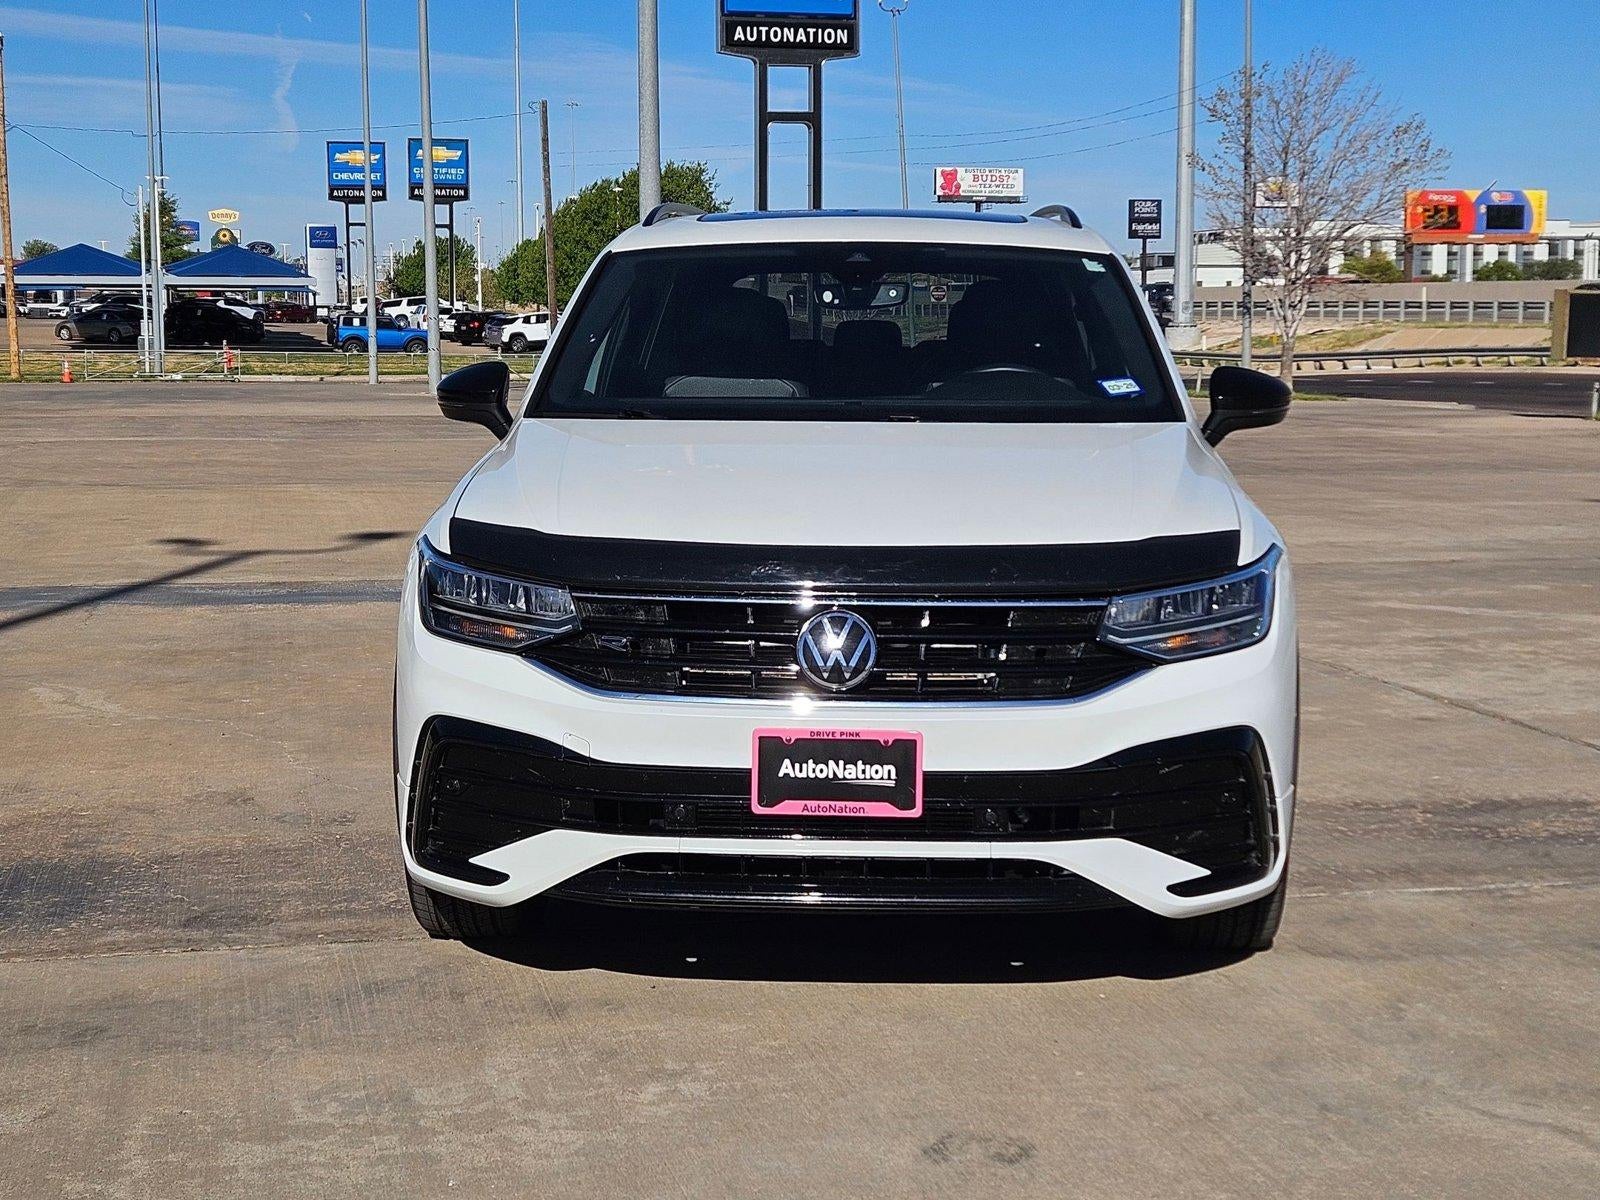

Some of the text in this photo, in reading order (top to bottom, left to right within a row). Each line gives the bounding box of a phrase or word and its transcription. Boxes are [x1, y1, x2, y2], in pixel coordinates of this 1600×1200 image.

[733, 25, 848, 44] AUTONATION
[413, 167, 465, 175] CTIFIED
[333, 172, 381, 180] CHEVROET
[972, 174, 1011, 183] BUDS?
[333, 189, 383, 197] AUTONAON
[413, 188, 465, 196] AUNATION
[210, 212, 237, 220] Denny's
[253, 243, 271, 254] Ford
[778, 758, 897, 780] AutoNation
[801, 803, 867, 814] AutoNation
